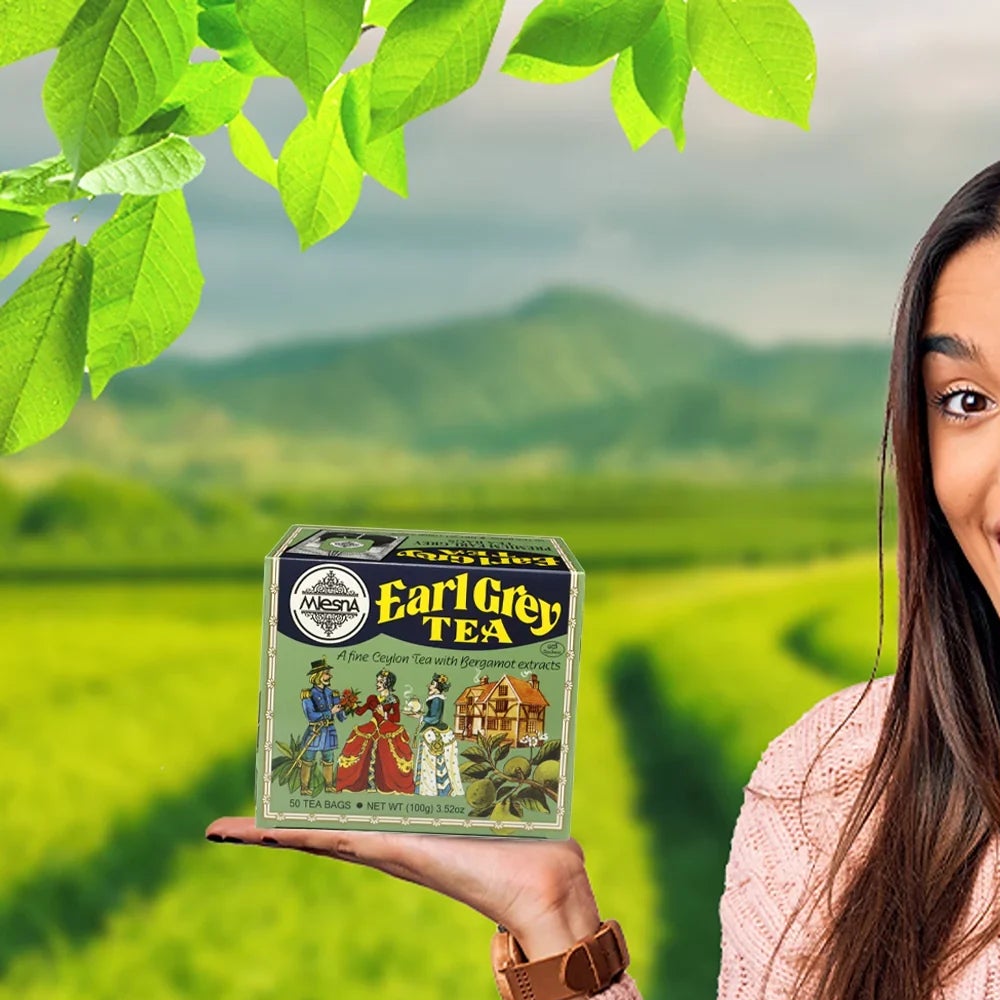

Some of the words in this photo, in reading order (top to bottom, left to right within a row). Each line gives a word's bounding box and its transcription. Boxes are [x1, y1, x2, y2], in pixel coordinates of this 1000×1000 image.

[376, 572, 468, 624] Earl
[473, 576, 561, 636] Grey
[422, 616, 512, 643] TEA
[337, 650, 346, 660] A
[347, 651, 369, 663] fine
[372, 652, 409, 666] Ceylon
[412, 653, 432, 666] Tea
[435, 654, 458, 666] with
[460, 656, 516, 670] Bergamot
[518, 659, 561, 670] extracts
[289, 799, 300, 808] 50
[302, 800, 322, 809] TEA
[324, 800, 351, 810] BAGS
[367, 802, 385, 811] NET
[387, 803, 403, 812] WT
[405, 803, 433, 814] (100g)
[436, 804, 464, 814] 3.52oz
